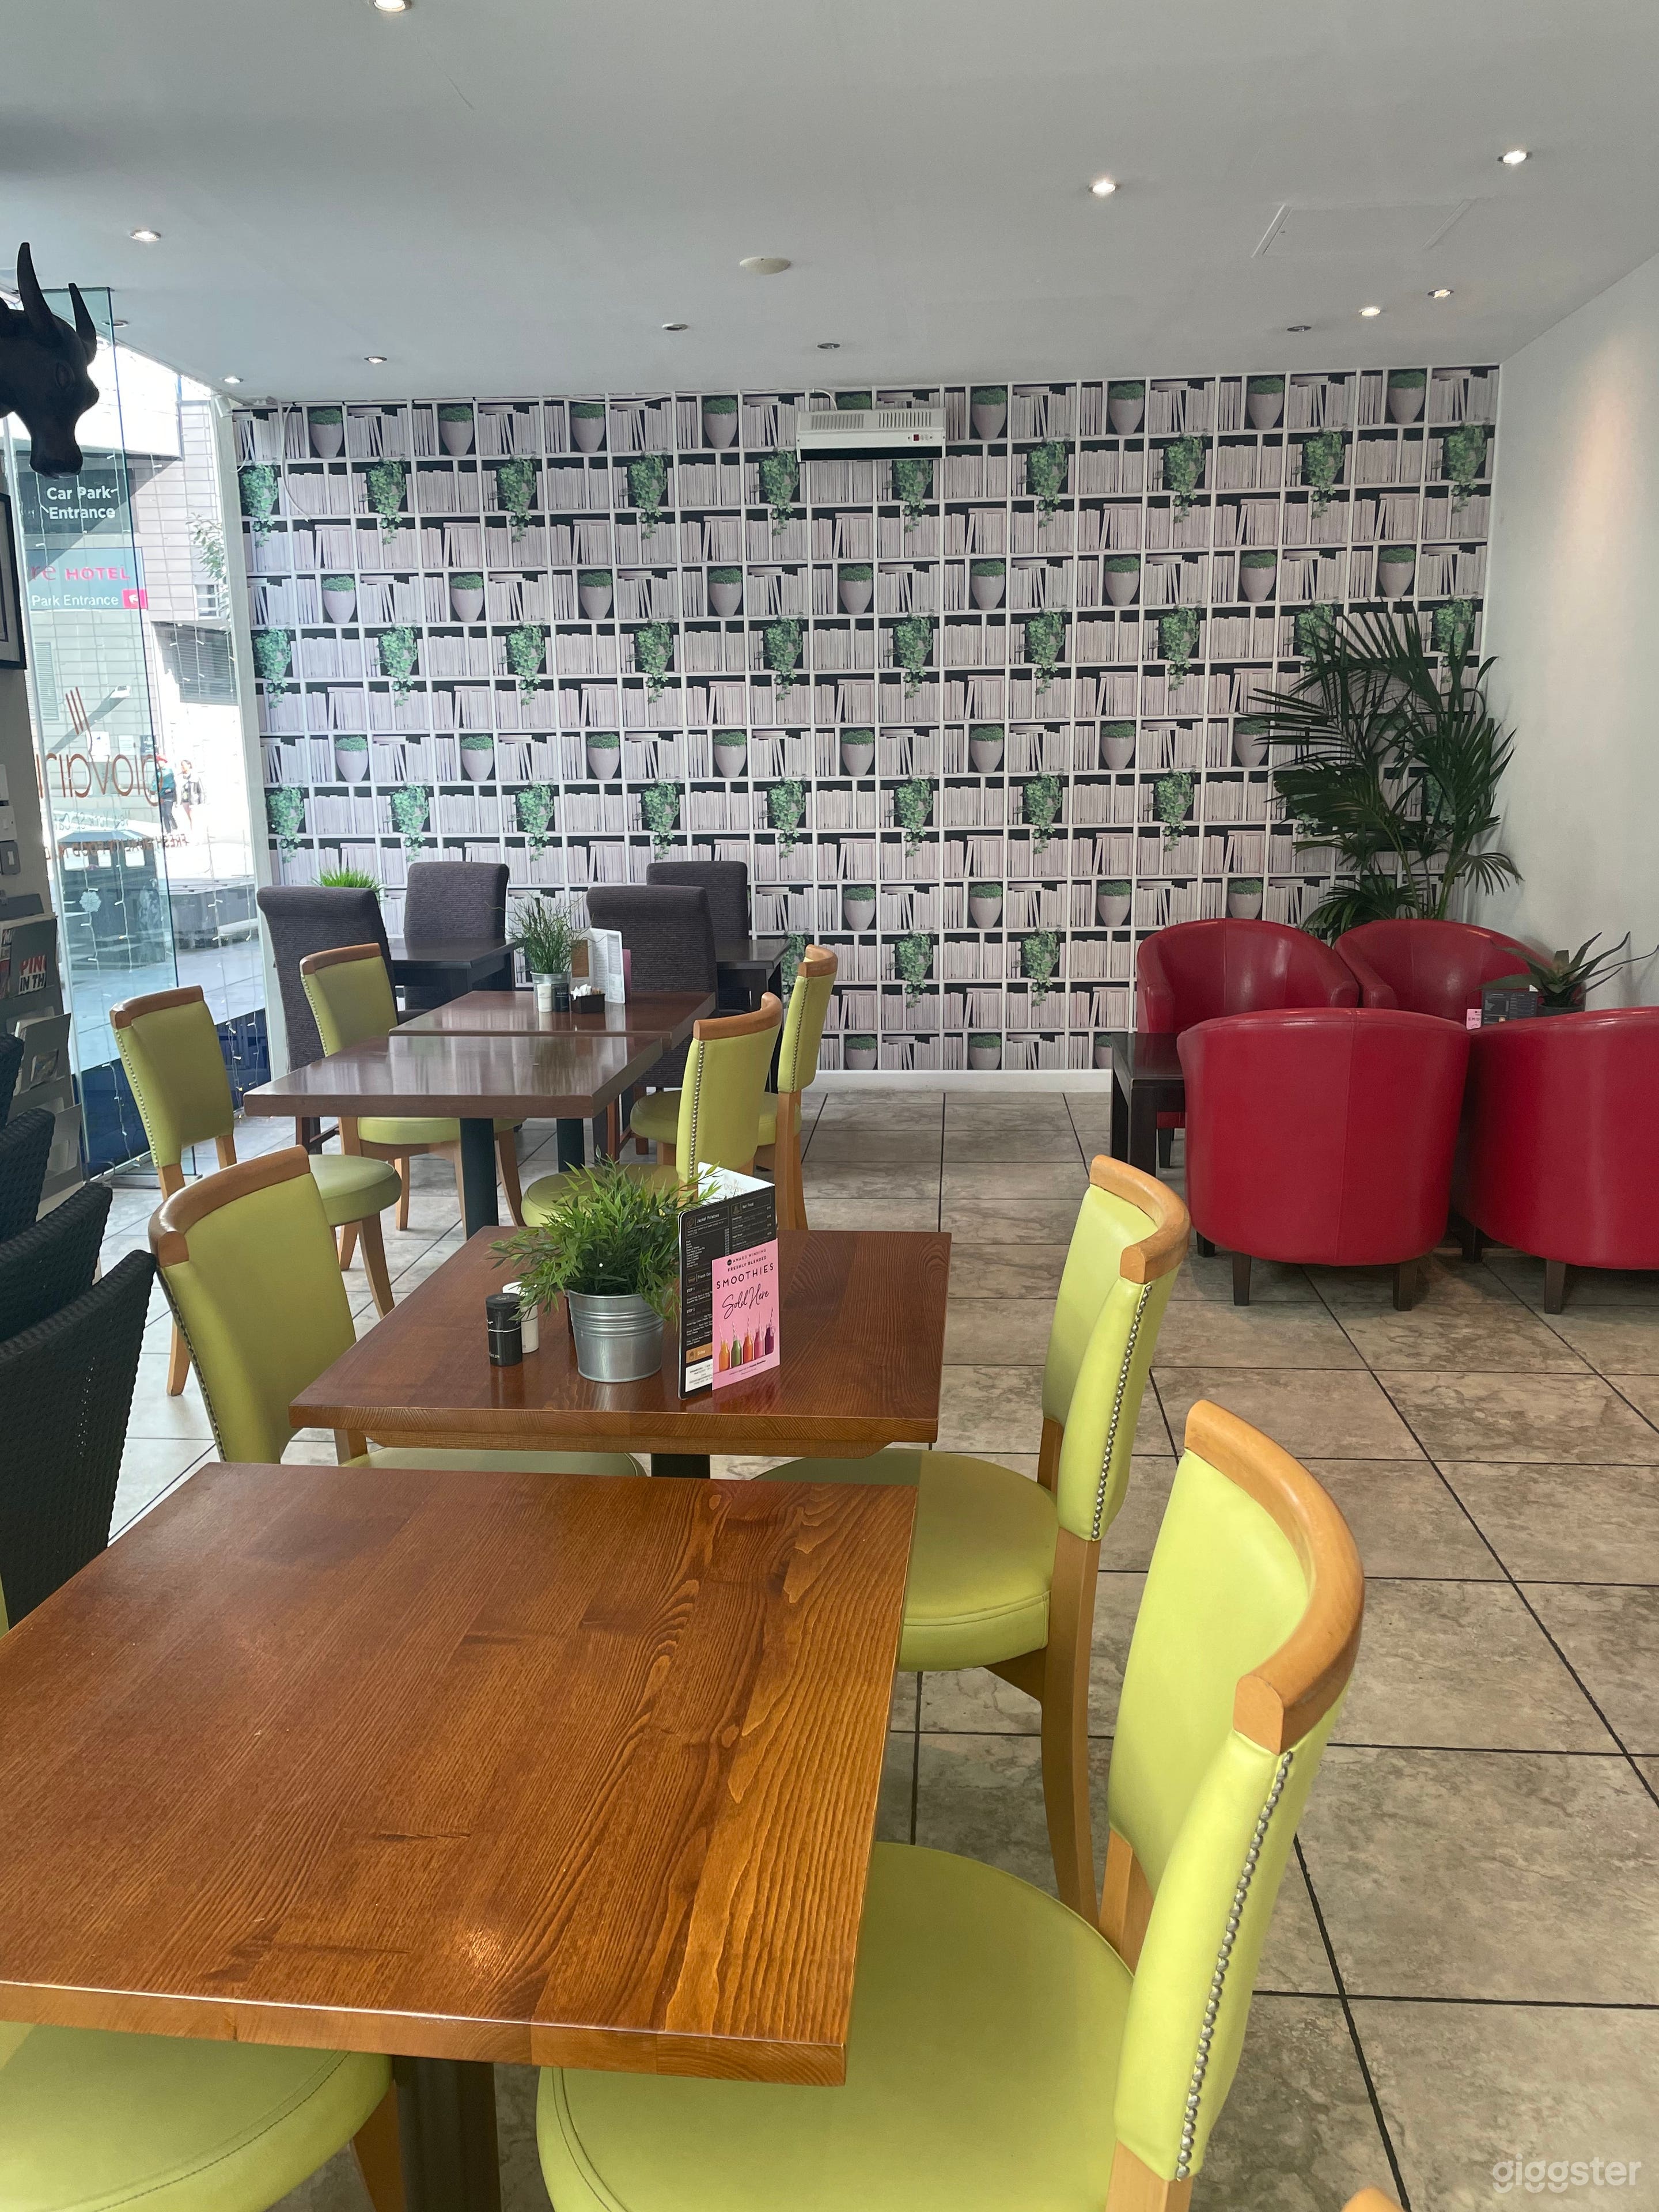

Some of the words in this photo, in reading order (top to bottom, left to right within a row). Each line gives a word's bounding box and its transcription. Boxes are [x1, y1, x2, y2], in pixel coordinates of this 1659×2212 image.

[47, 487, 73, 500] Car
[77, 486, 112, 499] Park
[49, 506, 116, 520] Entrance
[66, 567, 130, 581] HOTEL
[32, 595, 60, 606] Park
[64, 594, 119, 606] Entrance
[20, 976, 30, 992] IN
[748, 1248, 767, 1257] WINNING
[728, 1263, 746, 1272] FRESHLY
[748, 1255, 767, 1266] BLENDED
[716, 1263, 774, 1289] SMOOTHIES
[722, 1290, 749, 1320] Sold
[748, 1283, 770, 1309] Here
